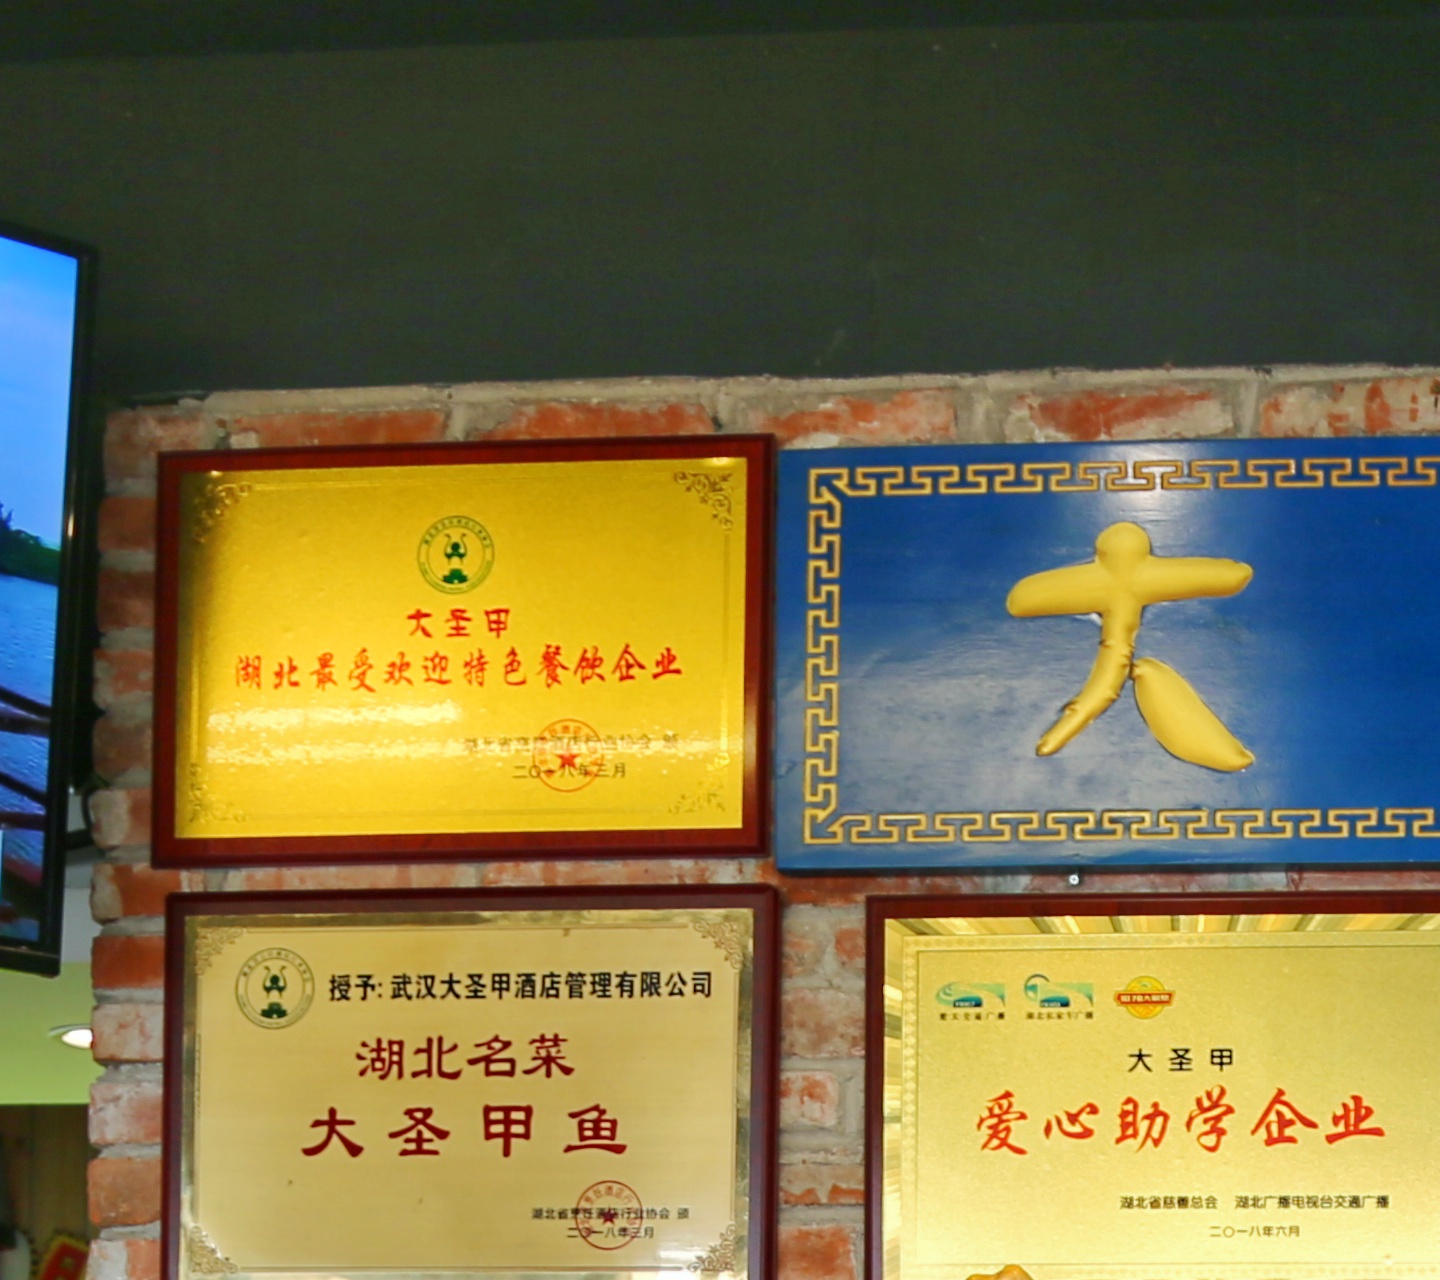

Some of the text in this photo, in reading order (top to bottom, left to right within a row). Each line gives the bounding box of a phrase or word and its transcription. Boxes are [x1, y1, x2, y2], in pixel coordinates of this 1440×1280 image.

[406, 608, 511, 639] 大圣甲
[236, 643, 683, 693] 湖北最受欢迎特色餐饮企业
[355, 1033, 575, 1081] 湖北名菜
[1128, 1048, 1235, 1074] 大圣甲
[301, 1104, 628, 1159] 大圣甲鱼
[976, 1084, 1386, 1156] 爱心助学企业
[1119, 1194, 1390, 1211] 湖北省慈善总会 湖北广播电视台交通广播
